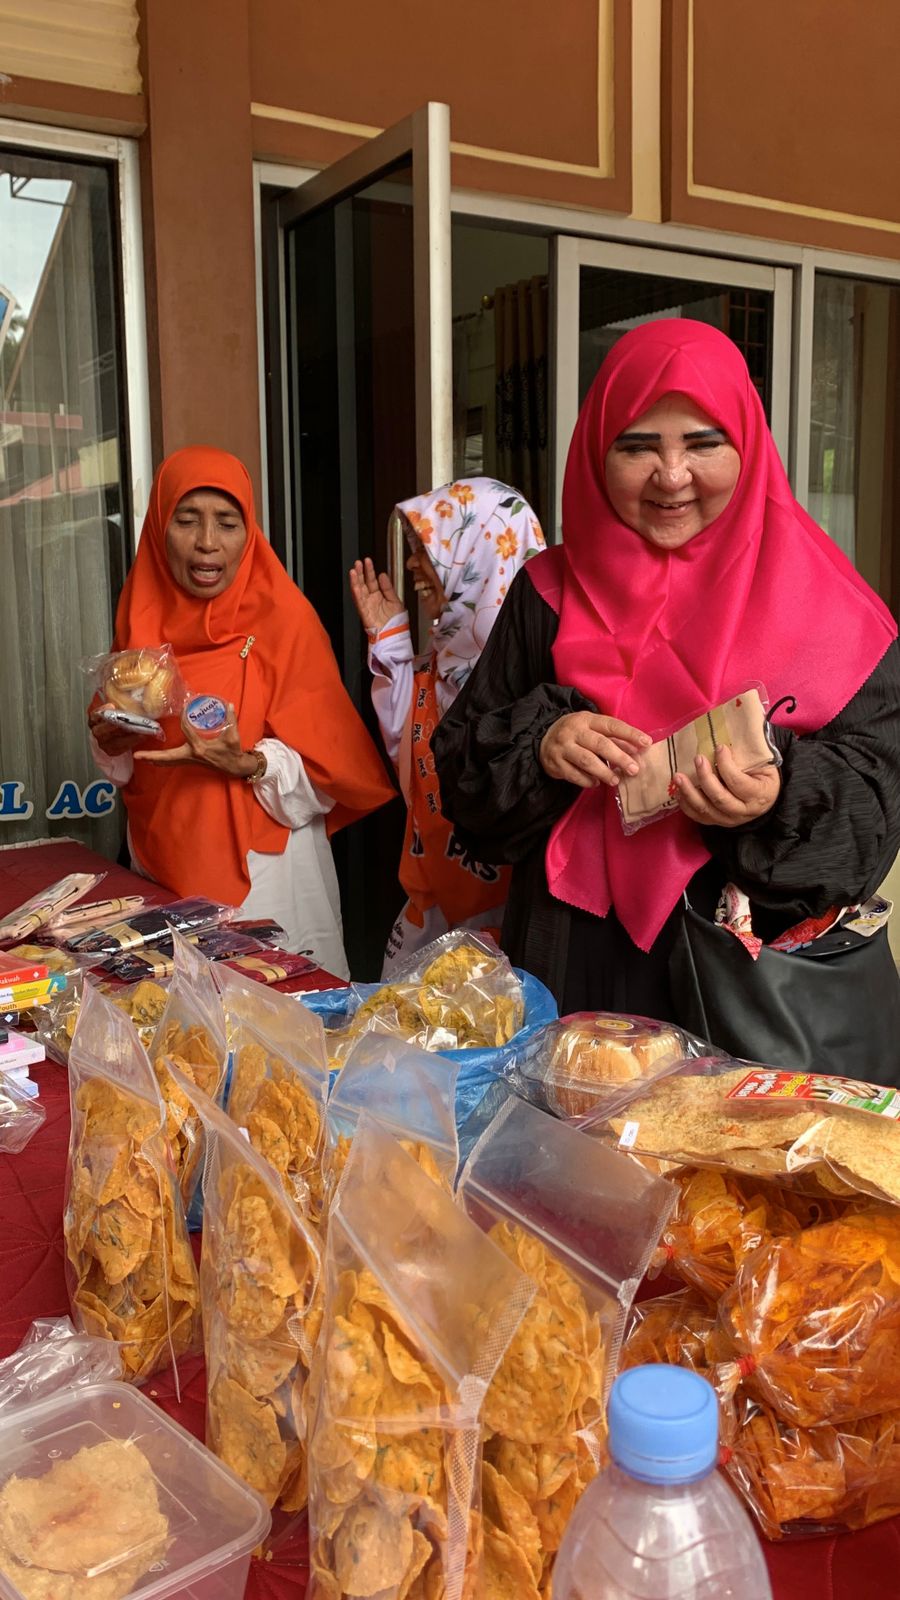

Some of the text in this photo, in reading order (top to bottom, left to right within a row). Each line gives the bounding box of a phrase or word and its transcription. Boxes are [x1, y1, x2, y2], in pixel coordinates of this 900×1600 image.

[416, 687, 427, 708] PKS
[412, 722, 422, 743] PKS
[416, 757, 428, 778] PKS
[47, 780, 116, 819] AC
[426, 792, 438, 814] PKS
[446, 833, 499, 881] PKS
